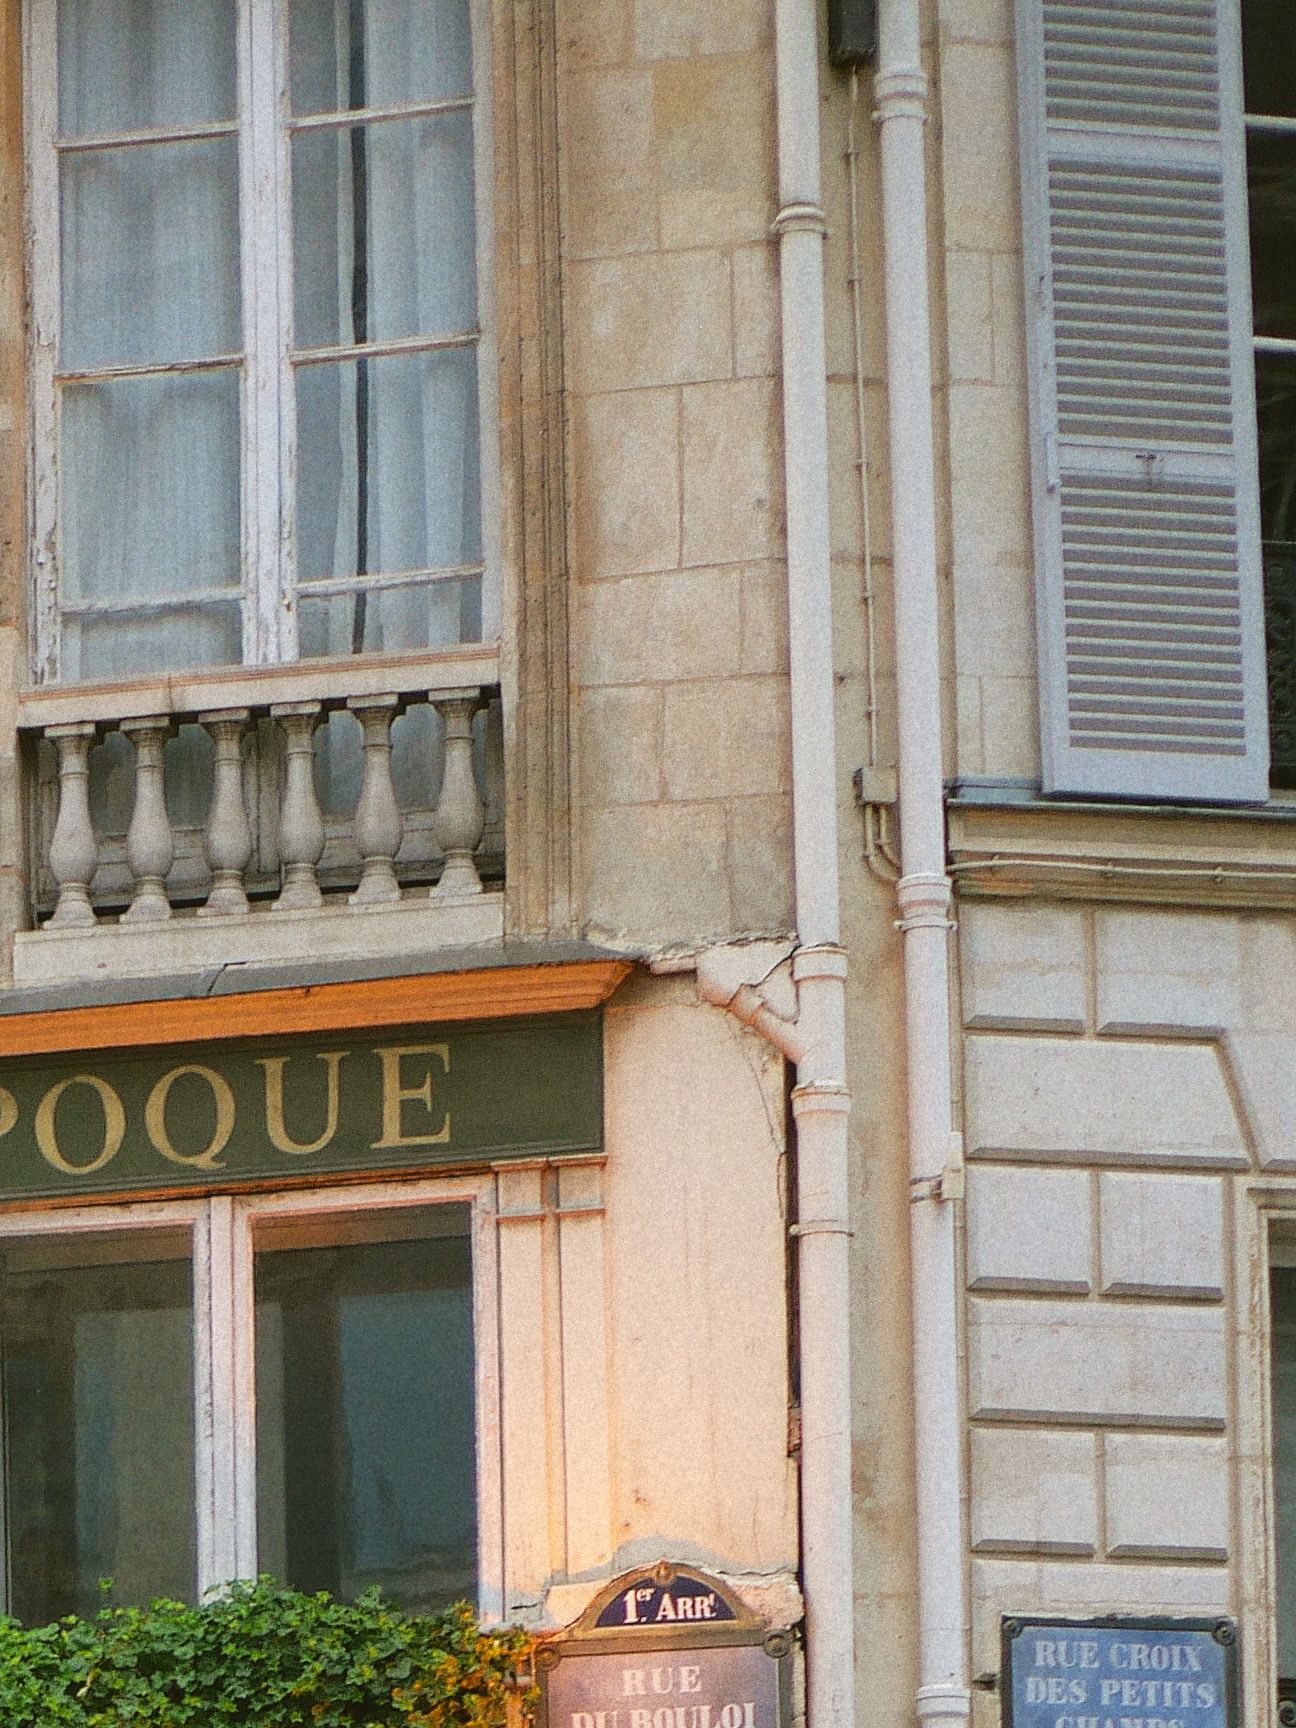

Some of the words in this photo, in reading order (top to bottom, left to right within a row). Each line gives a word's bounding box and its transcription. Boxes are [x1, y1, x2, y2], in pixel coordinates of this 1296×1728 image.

[1034, 1640, 1100, 1670] RUE
[1109, 1642, 1204, 1672] CROIX
[621, 1665, 702, 1697] RUE
[1024, 1675, 1089, 1706] DES
[1099, 1678, 1218, 1709] PETITS
